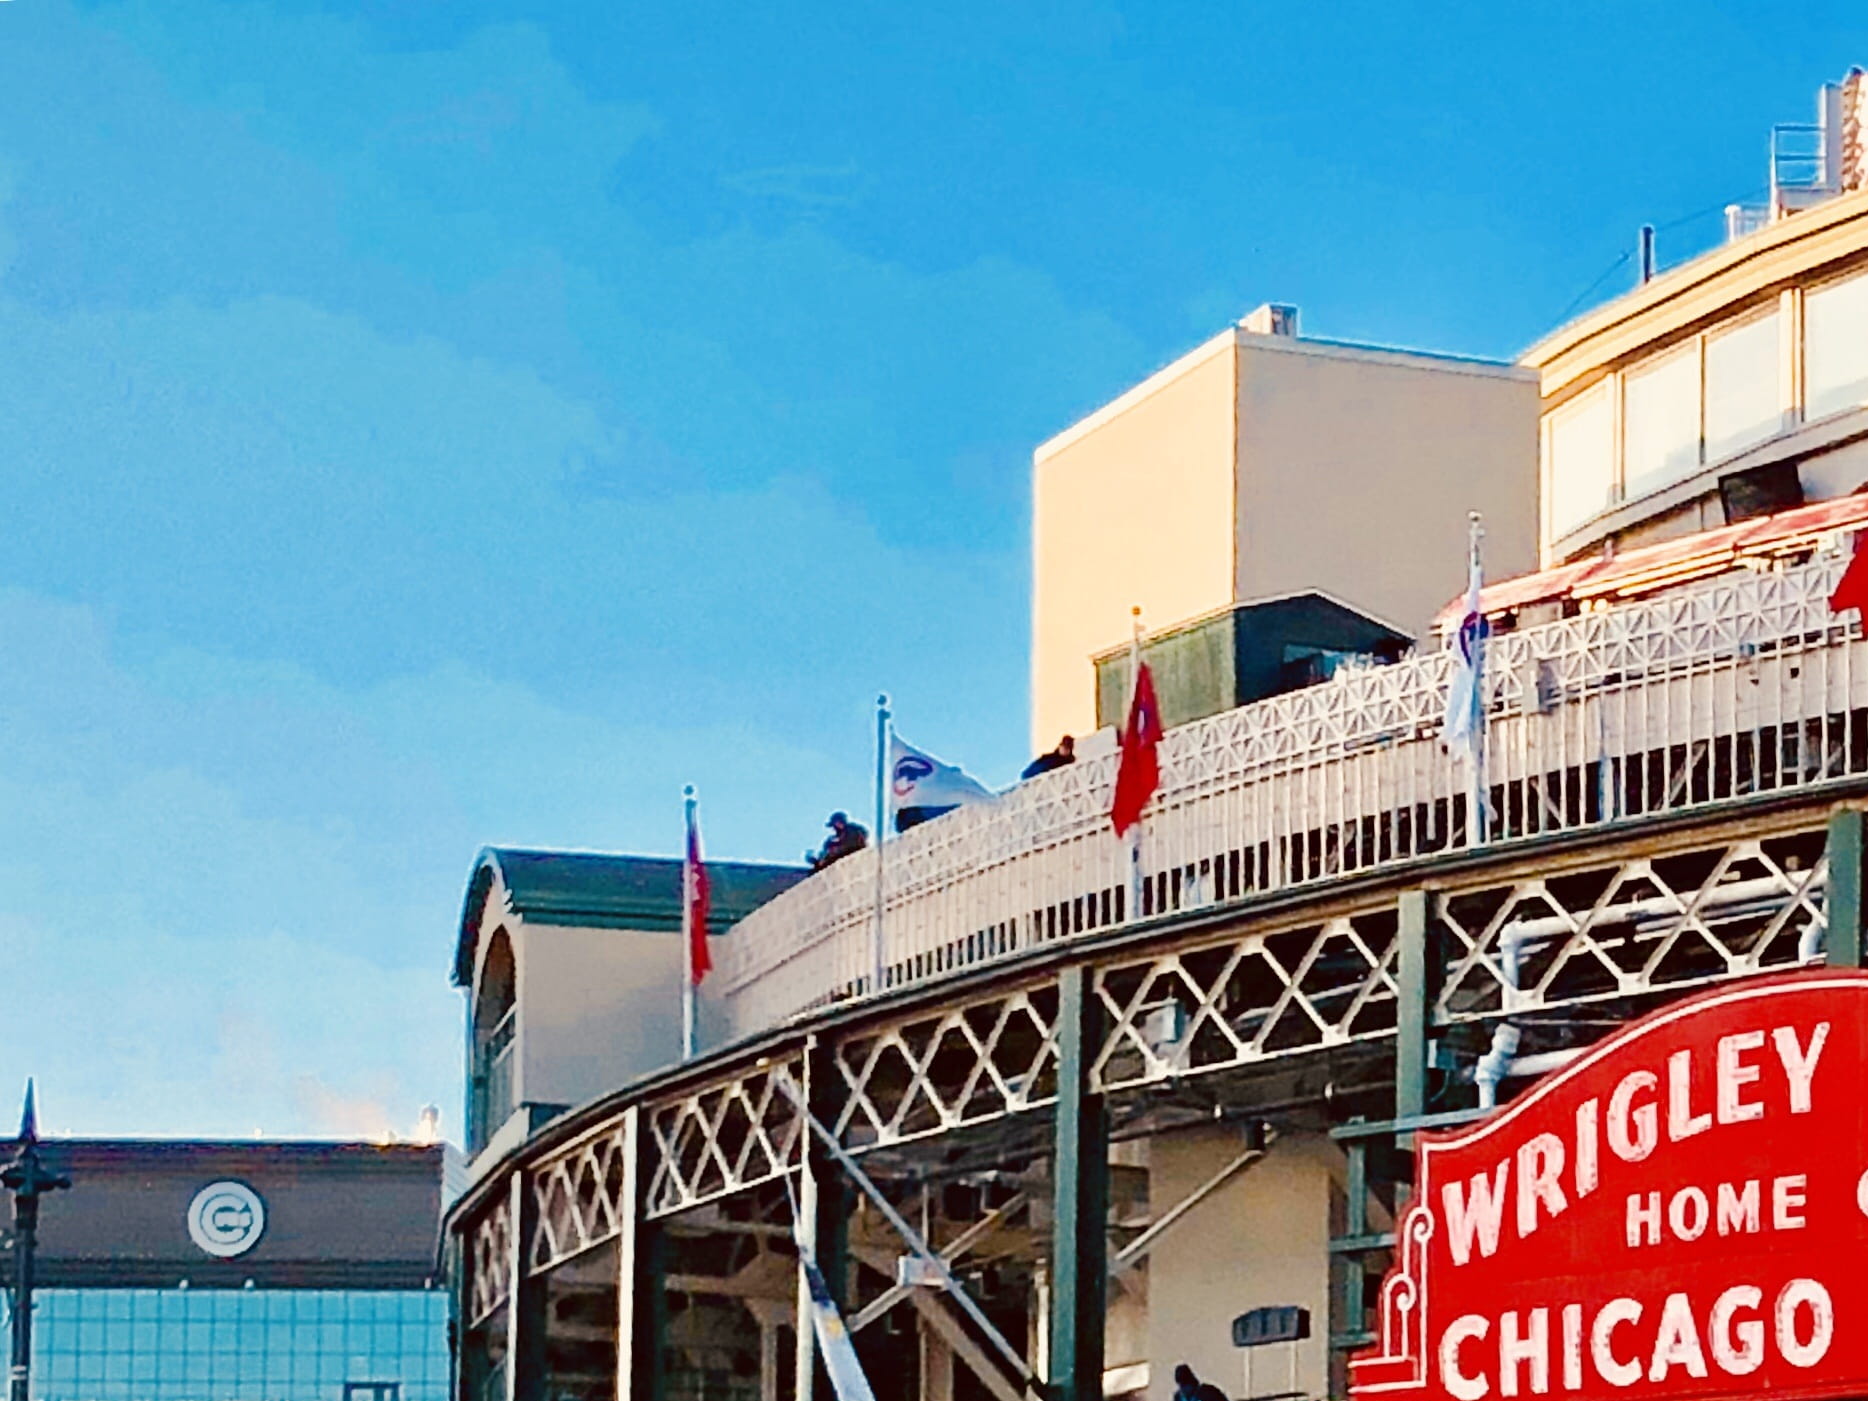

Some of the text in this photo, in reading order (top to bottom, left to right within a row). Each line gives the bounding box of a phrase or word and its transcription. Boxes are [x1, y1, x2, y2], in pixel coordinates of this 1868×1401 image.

[1441, 1021, 1831, 1266] WRIGLEY
[1626, 1174, 1808, 1247] HOME
[1438, 1278, 1834, 1401] CHICAGO
